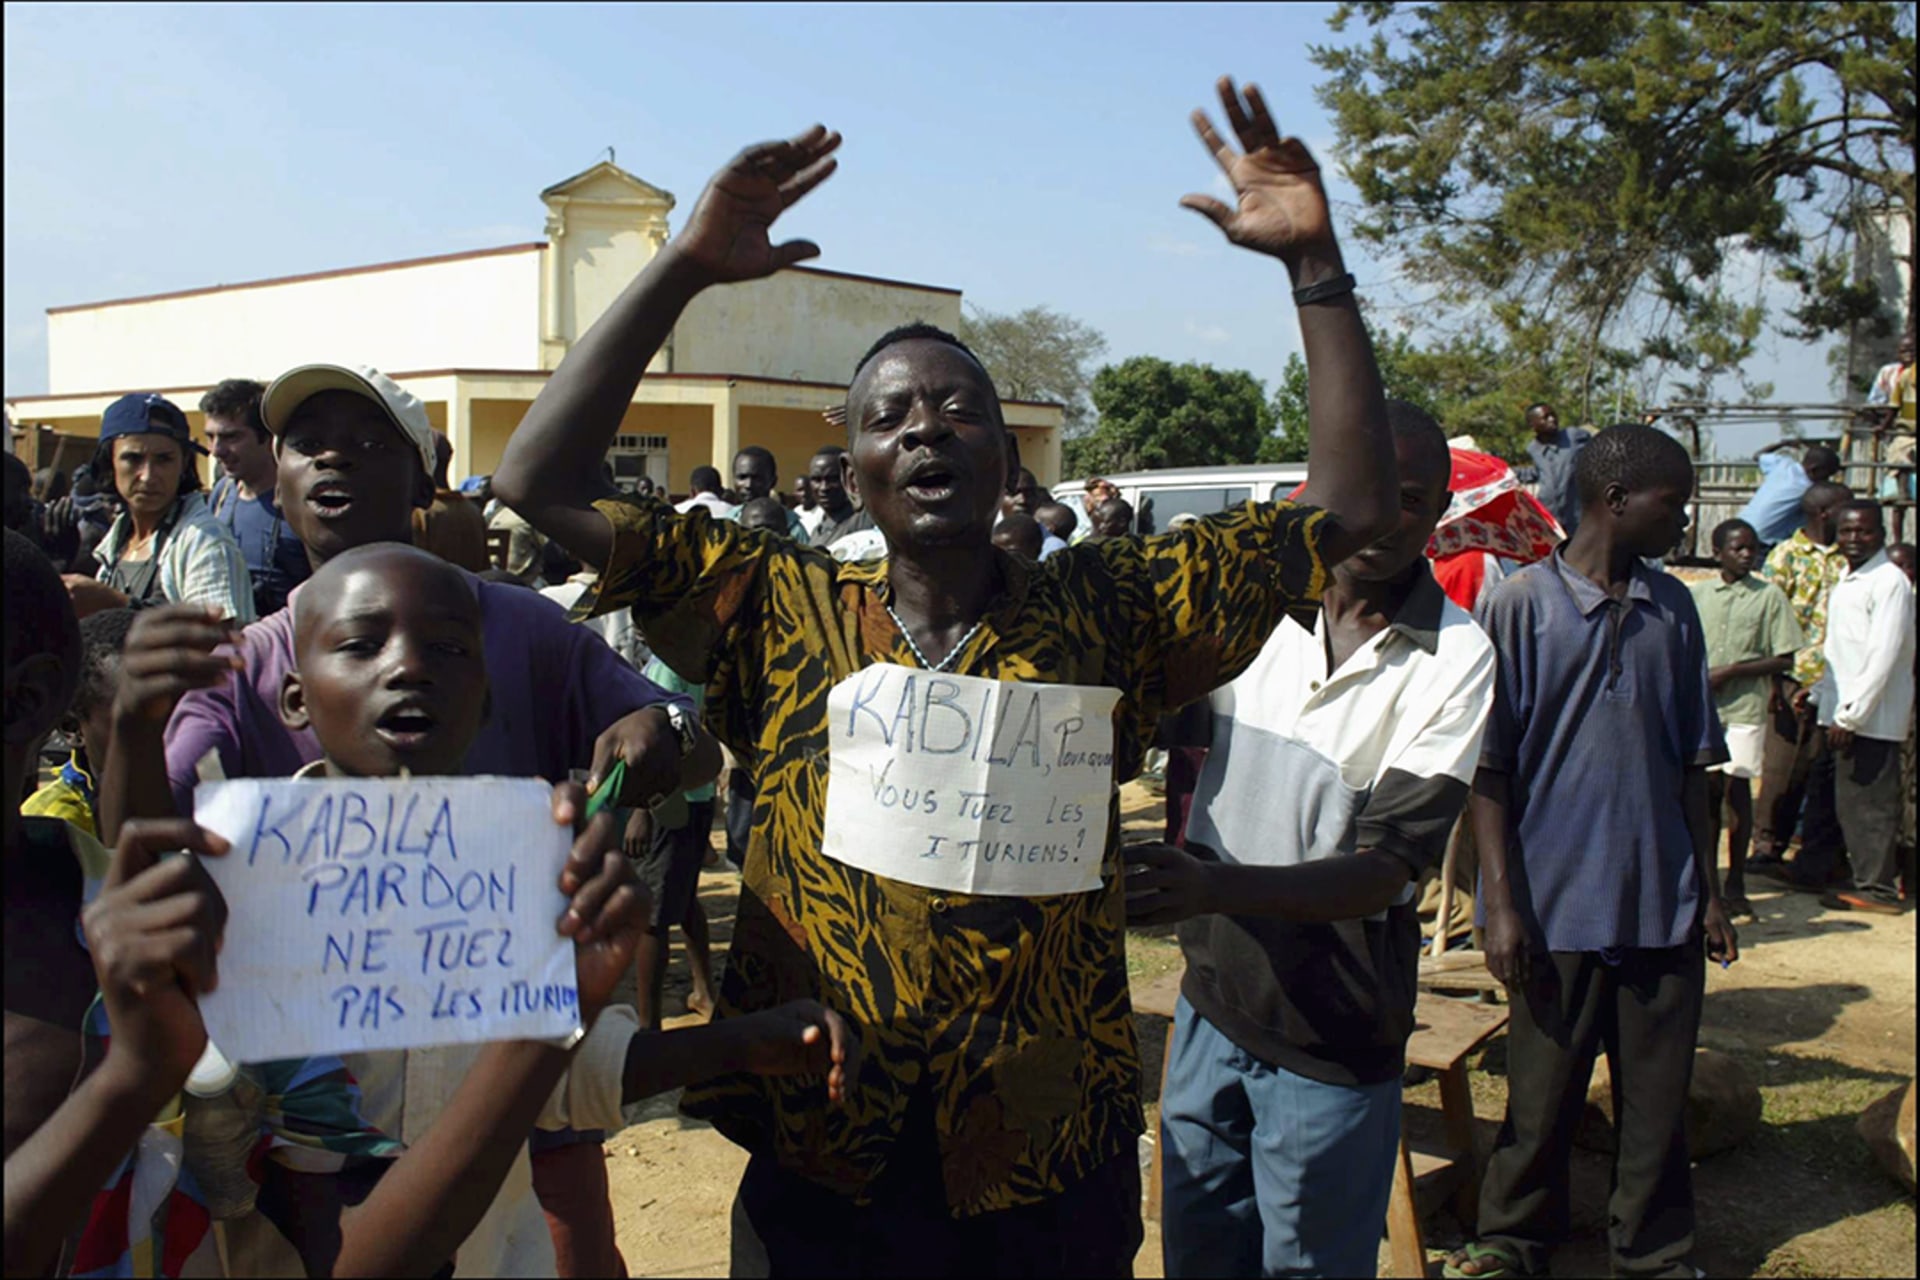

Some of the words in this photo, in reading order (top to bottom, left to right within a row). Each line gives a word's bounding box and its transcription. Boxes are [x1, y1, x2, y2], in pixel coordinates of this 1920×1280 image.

[870, 758, 938, 814] VOUS
[958, 791, 1014, 824] TUEZ
[1046, 796, 1083, 825] LES
[249, 791, 457, 866] KABILA
[304, 862, 516, 917] PARDON
[322, 929, 392, 974] NE
[414, 919, 515, 974] TUEZ
[330, 983, 405, 1029] PAS
[431, 981, 483, 1020] LES
